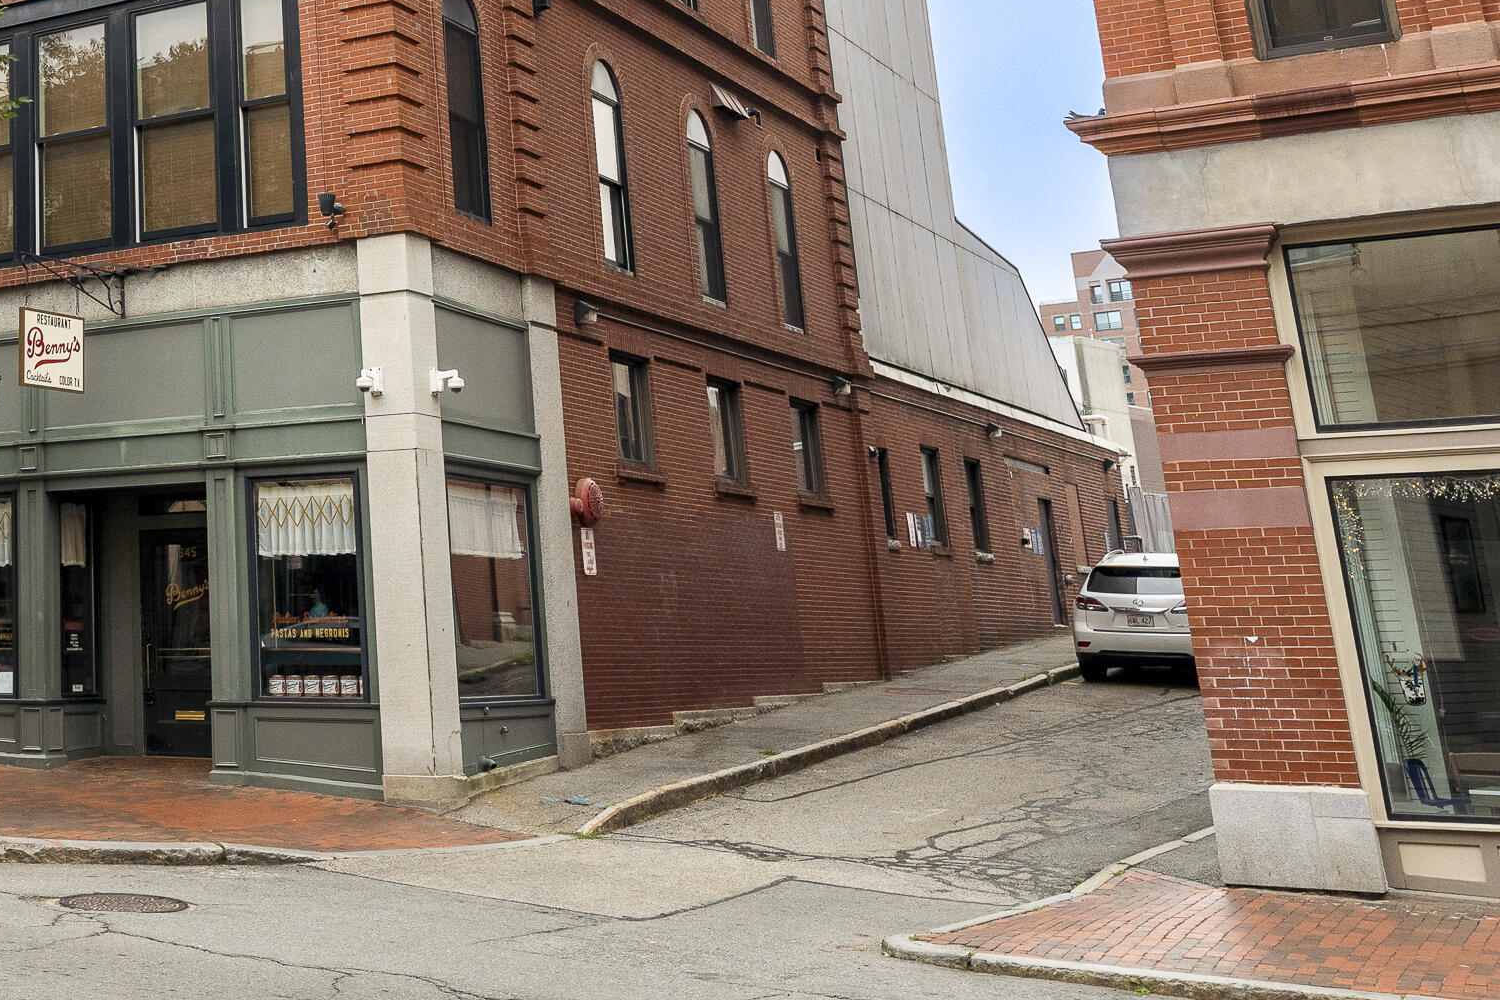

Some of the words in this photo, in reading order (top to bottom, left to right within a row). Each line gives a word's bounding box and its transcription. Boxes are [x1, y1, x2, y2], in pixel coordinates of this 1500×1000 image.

[37, 314, 71, 330] RESTAURANT
[27, 327, 80, 369] Benny's
[270, 628, 297, 638] PASTAS
[299, 629, 313, 638] AND
[315, 628, 350, 638] NEGRONIS
